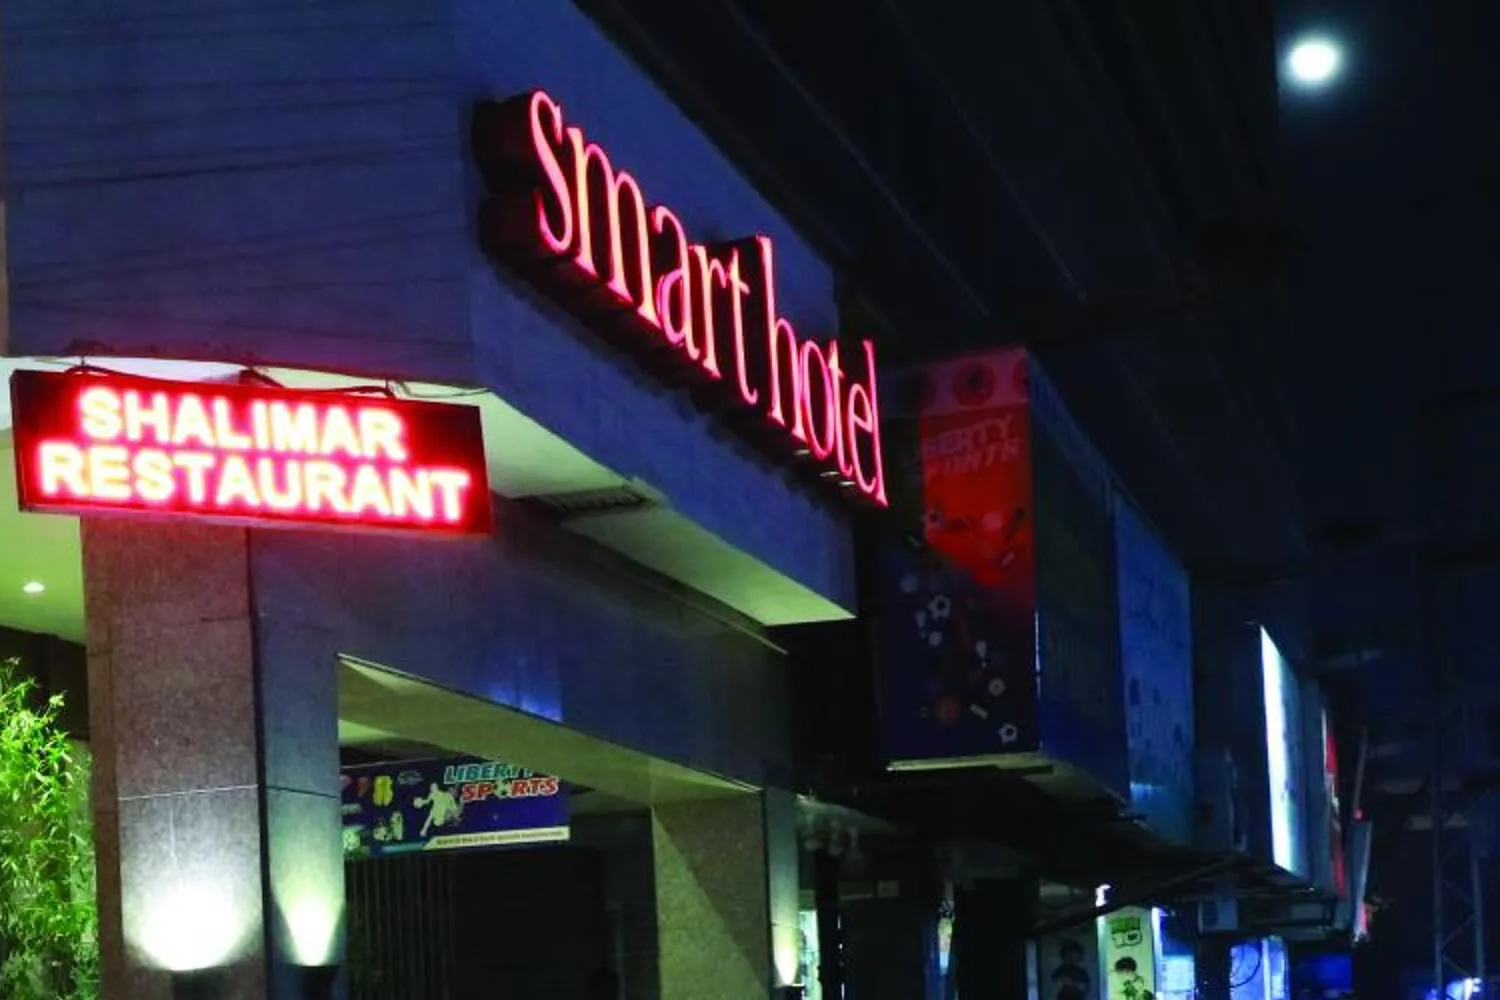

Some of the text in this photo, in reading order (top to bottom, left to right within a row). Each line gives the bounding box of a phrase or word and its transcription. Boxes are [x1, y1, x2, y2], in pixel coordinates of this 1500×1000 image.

[528, 87, 890, 509] smart hotel
[76, 384, 408, 462] SHALIMAR
[35, 438, 471, 523] RESTAURANT
